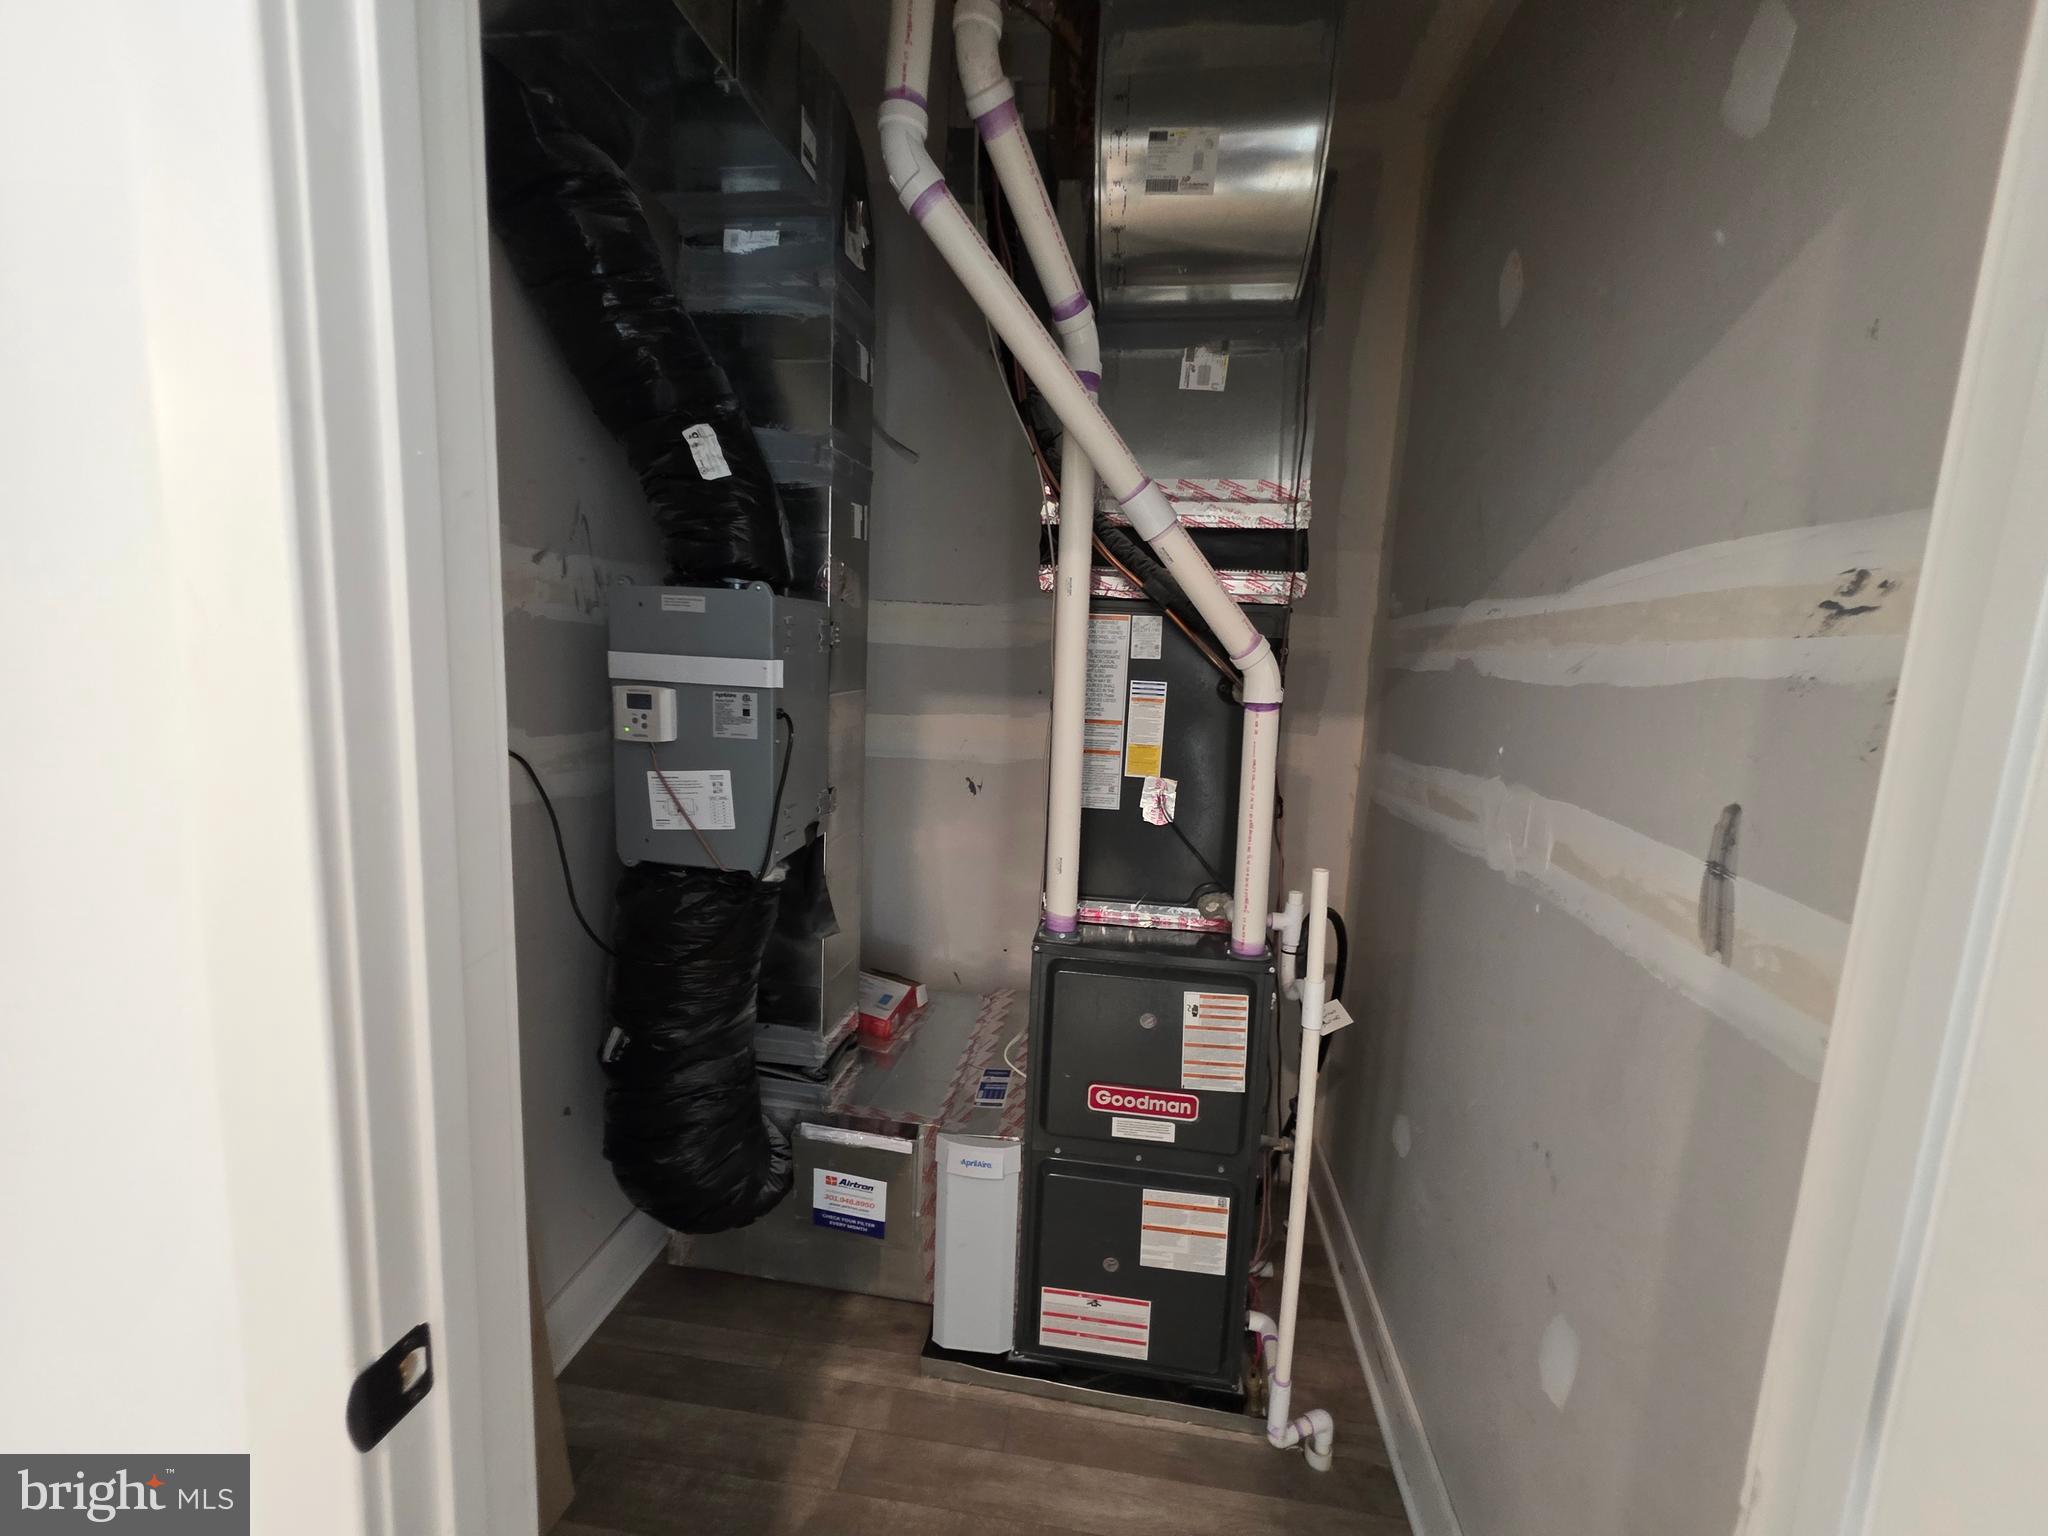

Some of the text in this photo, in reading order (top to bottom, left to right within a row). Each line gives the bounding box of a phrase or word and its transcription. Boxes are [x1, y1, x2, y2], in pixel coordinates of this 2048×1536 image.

[1095, 1090, 1191, 1115] Goodman
[839, 1178, 874, 1191] Airtron
[822, 1213, 840, 1221] CHECK
[857, 1220, 875, 1228] FILTER
[829, 1220, 868, 1232] EVERY MONTH
